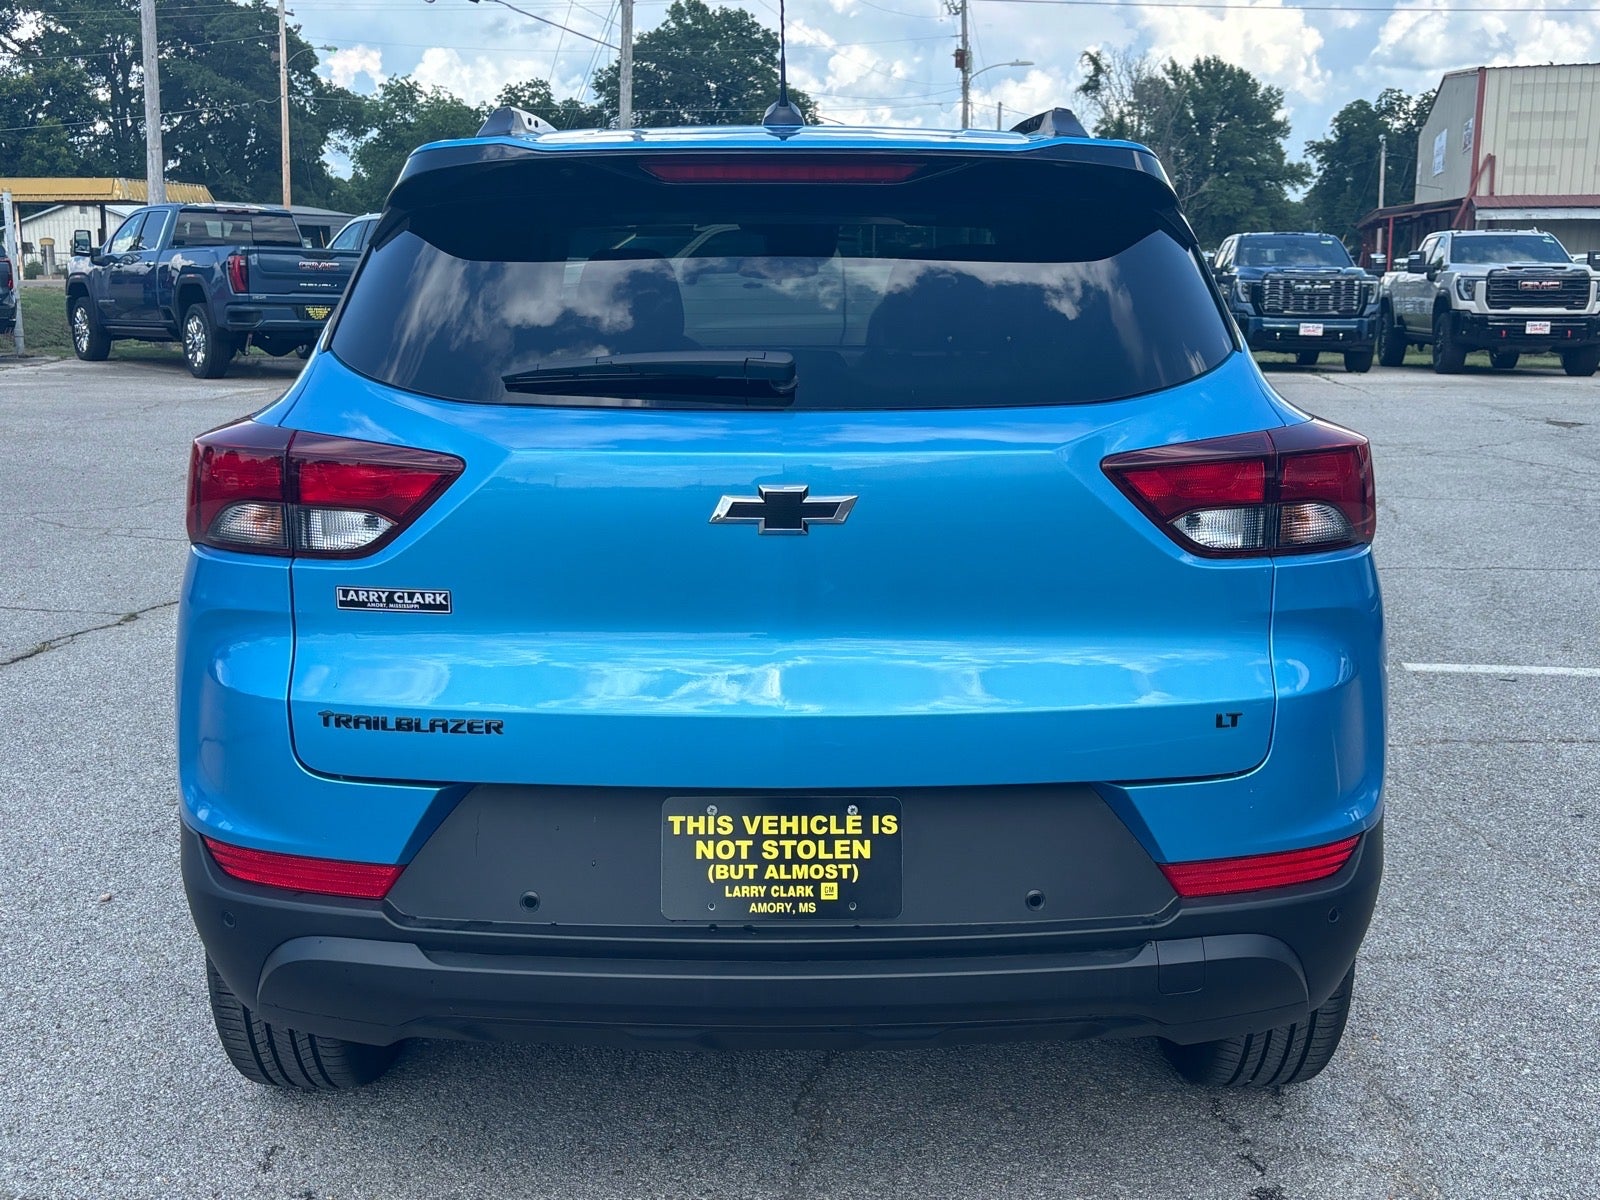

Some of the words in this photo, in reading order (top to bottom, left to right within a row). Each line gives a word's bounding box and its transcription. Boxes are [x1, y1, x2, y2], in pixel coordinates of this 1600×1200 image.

[1521, 281, 1560, 289] GMC
[339, 589, 389, 603] LARRY
[393, 592, 448, 605] CLARK
[318, 709, 504, 735] TRAILBLAZER
[1215, 712, 1243, 729] LT
[667, 815, 734, 835] THIS
[742, 814, 863, 835] VEHICLE
[872, 814, 898, 835] IS
[695, 840, 753, 860] NOT
[761, 839, 871, 860] STOLEN
[707, 864, 759, 883] (BUT
[764, 864, 859, 883] ALMOST)
[724, 885, 766, 898] LARRY
[771, 885, 814, 898] CLARK
[749, 902, 796, 914] AMORY,
[799, 902, 816, 913] MS
